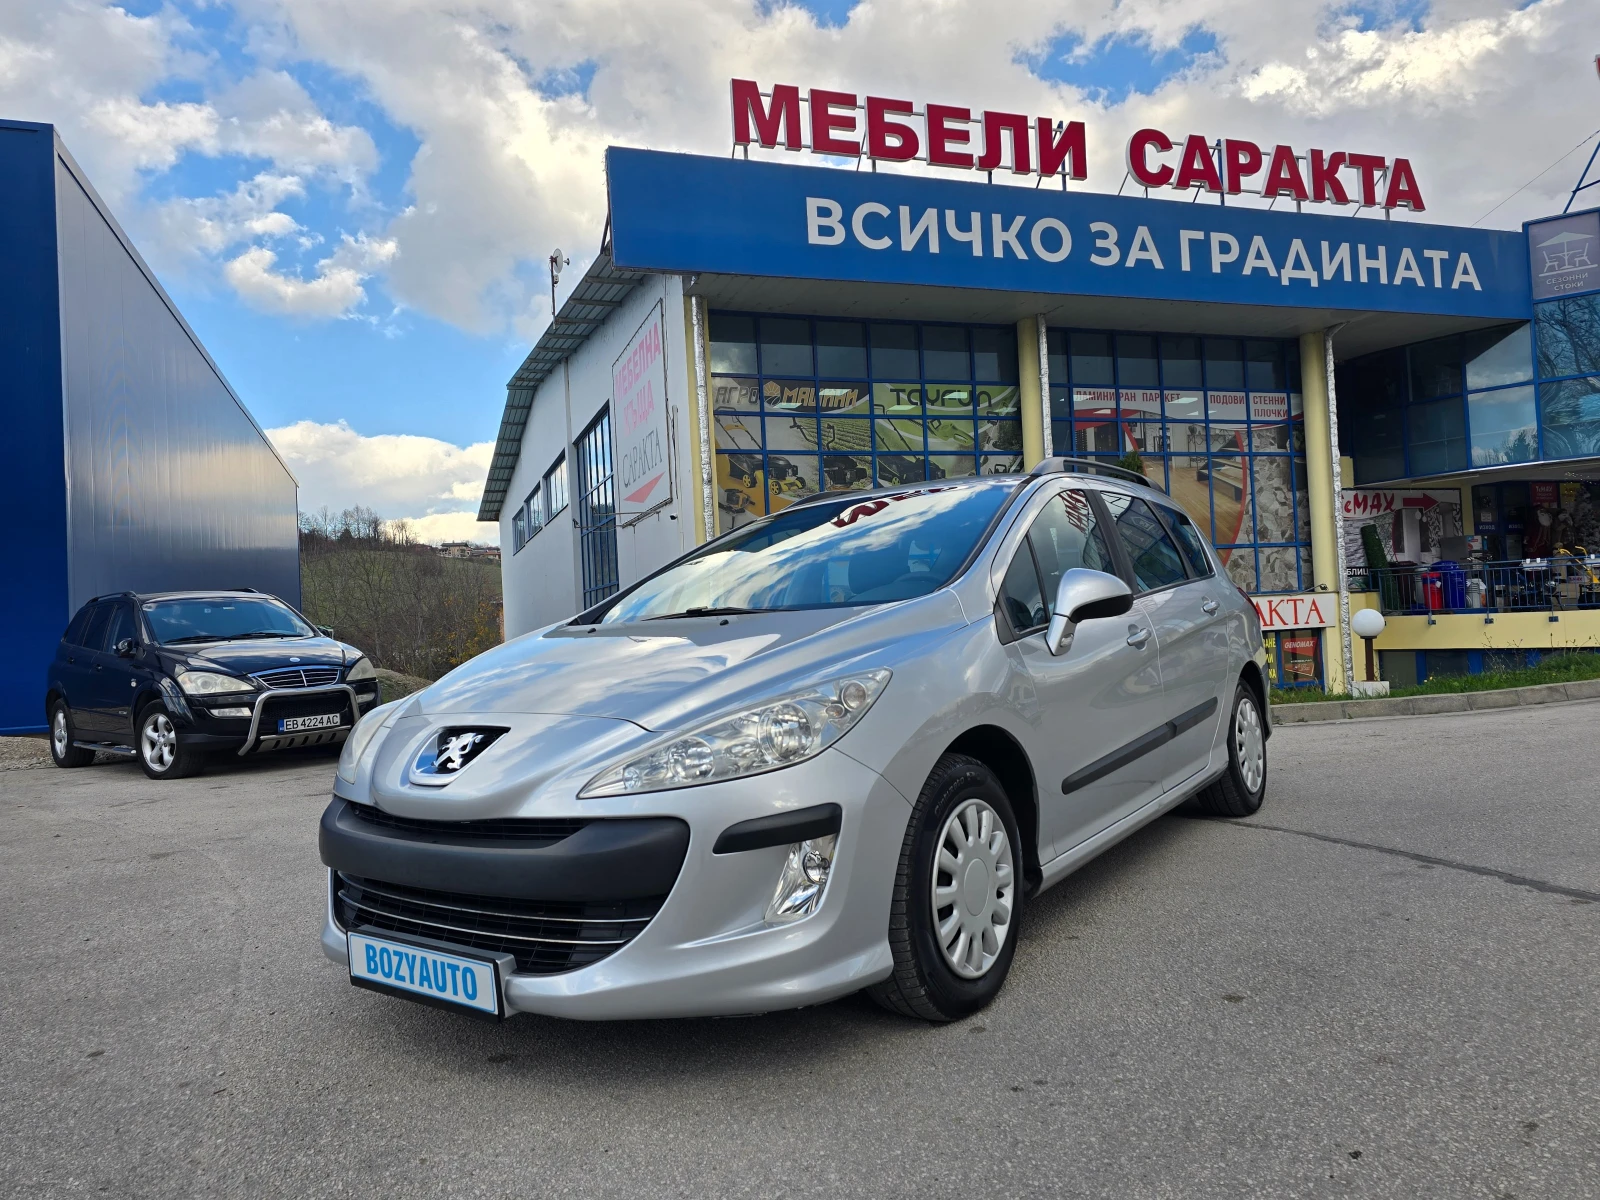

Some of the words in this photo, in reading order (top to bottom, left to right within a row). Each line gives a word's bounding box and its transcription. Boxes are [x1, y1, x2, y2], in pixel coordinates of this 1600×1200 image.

[730, 78, 1087, 180] МЕБЕЛИ
[1127, 128, 1425, 212] САРАКТА
[806, 197, 1072, 263] ВСИЧКО
[1090, 222, 1165, 270] ЗА
[1180, 229, 1482, 291] ГРАДИНАТА
[1546, 272, 1588, 285] СЕЗОННИ
[1554, 281, 1584, 291] СТОКИ
[615, 321, 662, 404] МЕБЕЛНА
[715, 386, 759, 405] АГРО
[1142, 392, 1181, 403] ПАРКЕТ
[1210, 394, 1245, 405] ПОДОВИ
[1253, 395, 1286, 406] СТЕННИ
[623, 379, 655, 438] КЪЩА
[1254, 408, 1288, 418] ПЛОЧКИ
[622, 426, 663, 489] САРАКТА
[1342, 492, 1397, 515] eMAX
[285, 719, 299, 730] EB
[300, 717, 324, 728] 4224
[326, 714, 339, 726] AC
[364, 943, 478, 1001] BOZYAUTO
